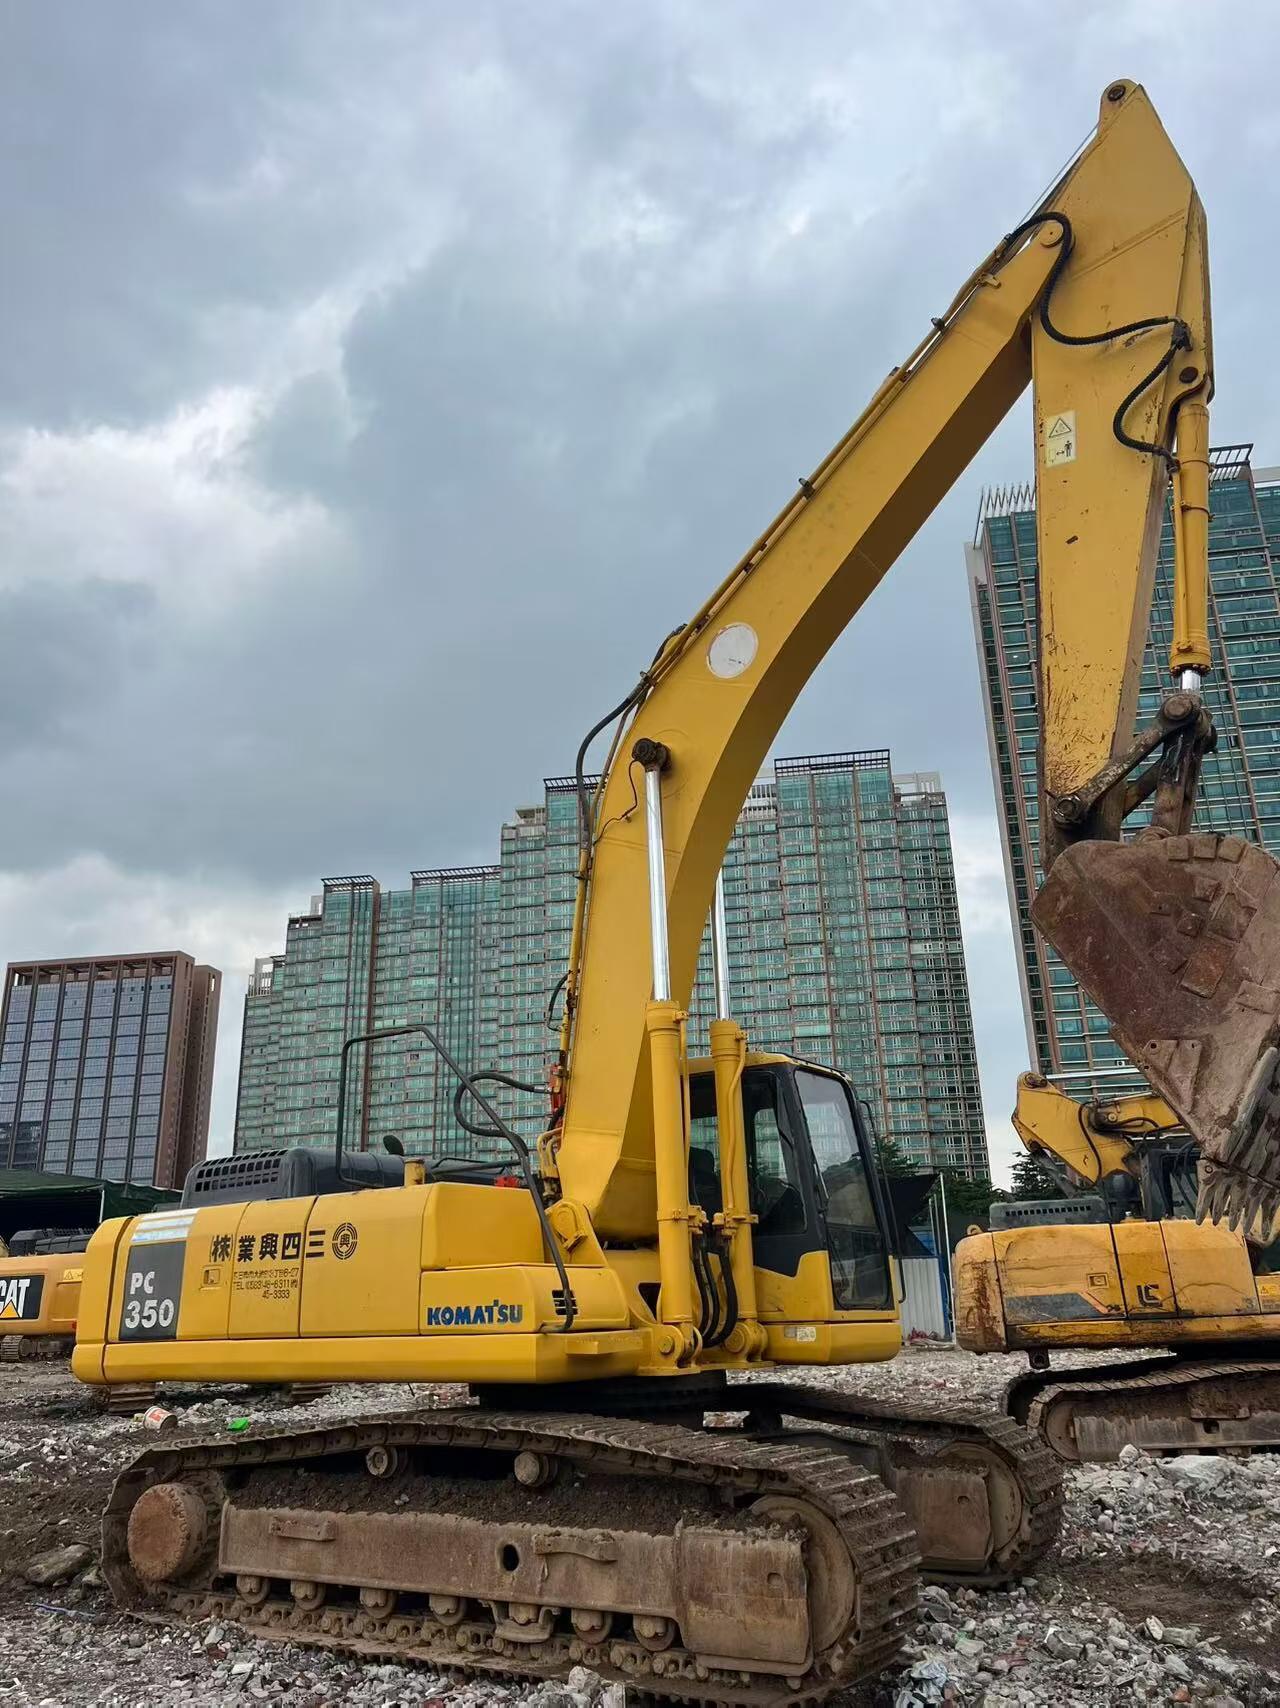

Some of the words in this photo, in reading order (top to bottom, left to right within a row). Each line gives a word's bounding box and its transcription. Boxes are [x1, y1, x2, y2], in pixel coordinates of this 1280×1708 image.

[130, 1271, 155, 1295] PC
[125, 1298, 174, 1329] 350
[427, 1299, 523, 1326] KOMATSU
